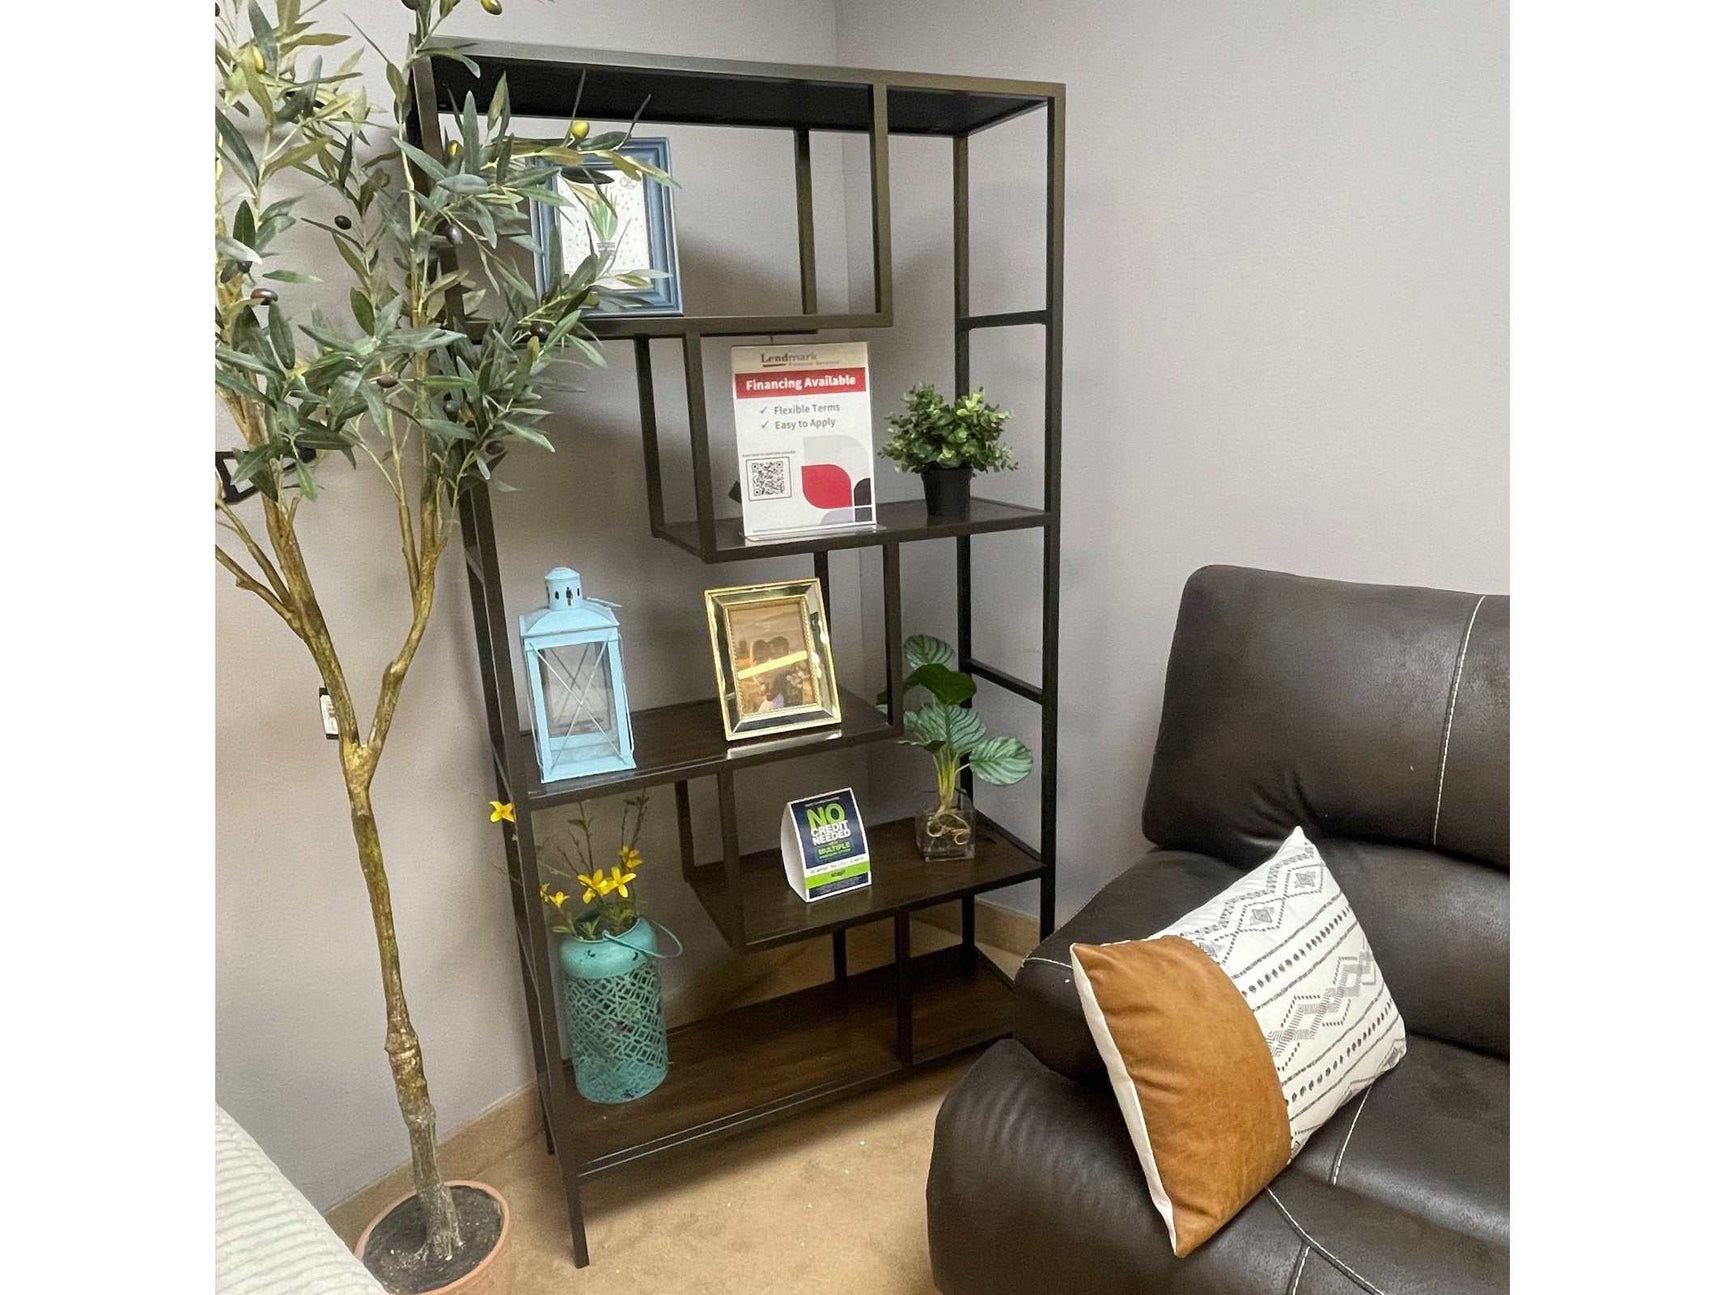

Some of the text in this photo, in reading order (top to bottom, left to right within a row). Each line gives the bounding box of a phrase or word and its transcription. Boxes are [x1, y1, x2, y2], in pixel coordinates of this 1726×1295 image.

[761, 352, 817, 363] Lendmark
[746, 375, 856, 391] Financing Available
[774, 404, 840, 415] Flexible Terms
[775, 418, 836, 430] Easy to Apply
[806, 803, 845, 829] NO
[811, 820, 848, 837] CREDIT
[812, 829, 851, 846] NEEDED
